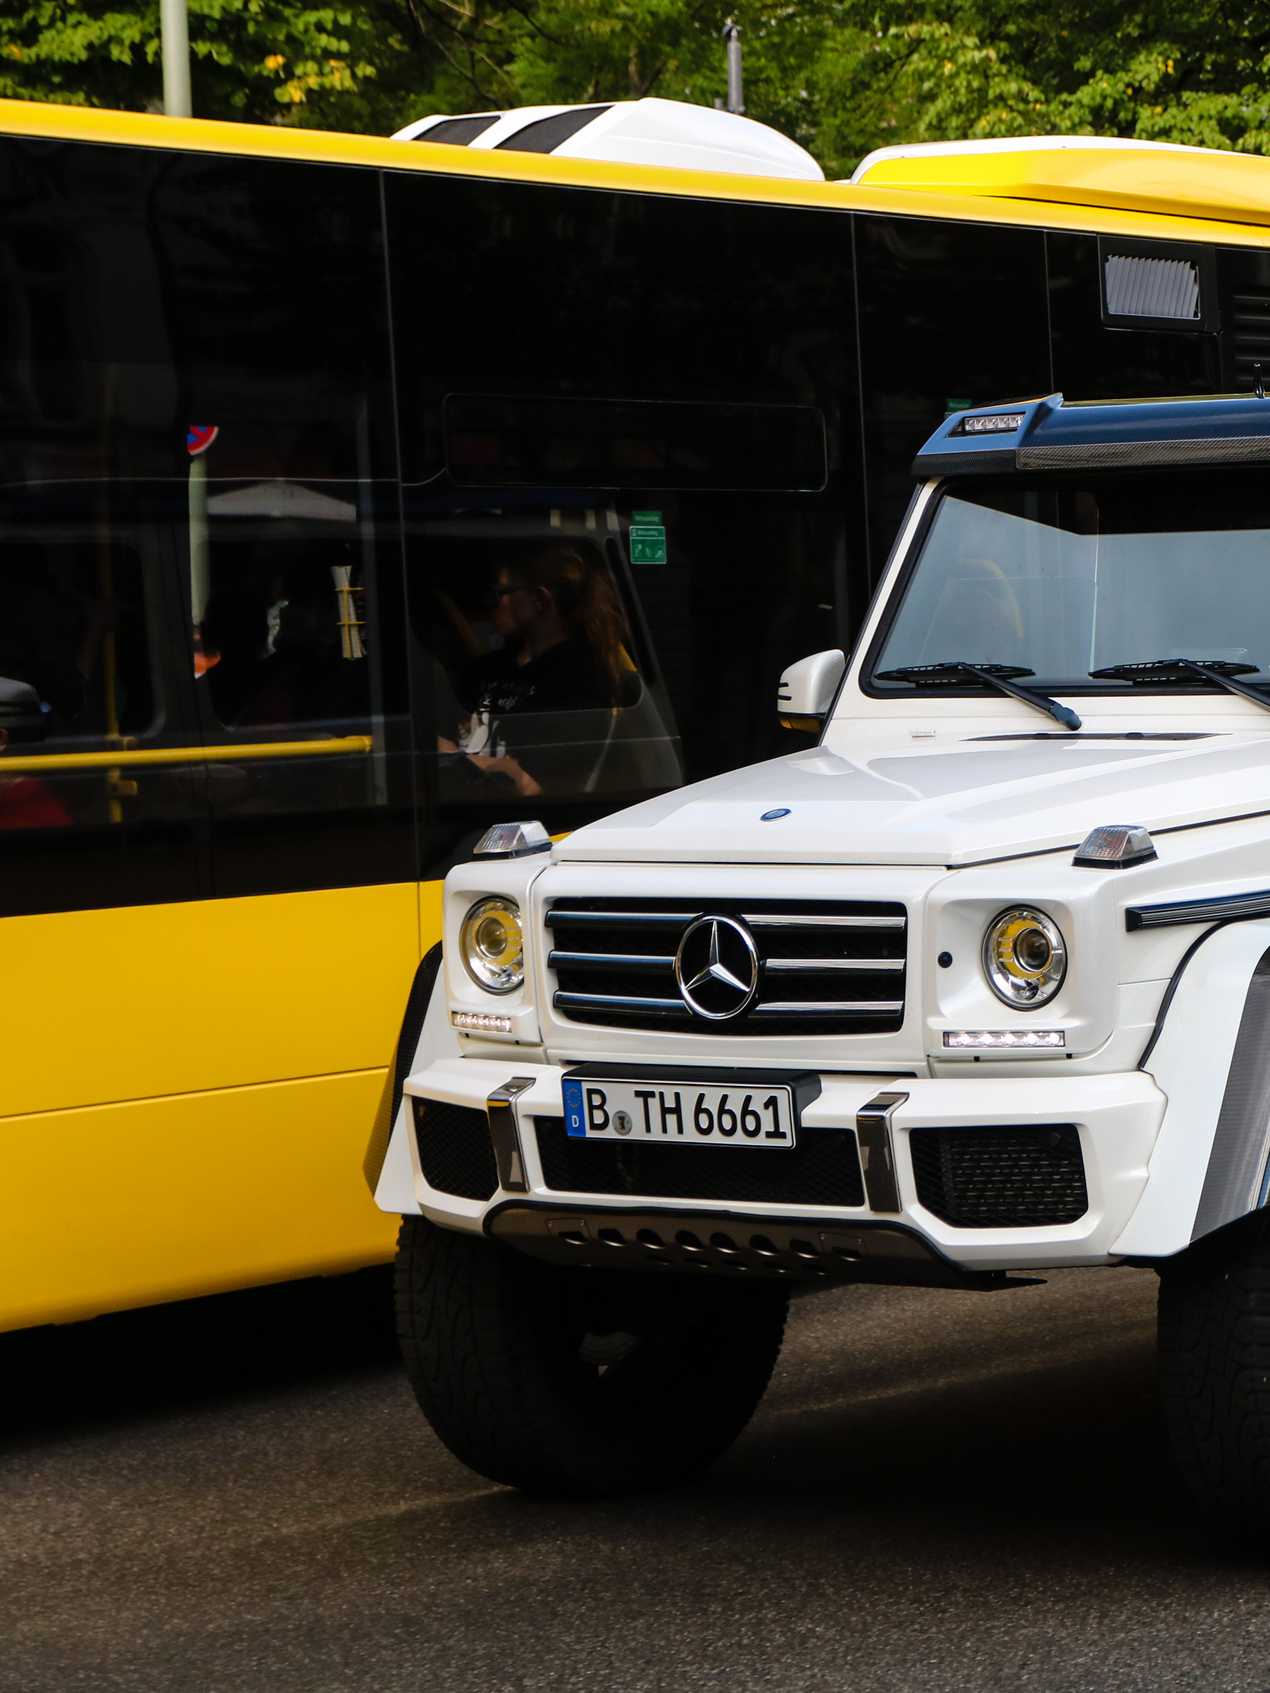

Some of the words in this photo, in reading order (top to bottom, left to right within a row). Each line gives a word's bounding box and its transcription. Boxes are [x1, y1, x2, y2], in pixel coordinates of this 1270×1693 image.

[571, 1115, 579, 1128] D
[586, 1088, 610, 1132] B
[634, 1090, 684, 1135] TH
[694, 1093, 788, 1140] 6661
